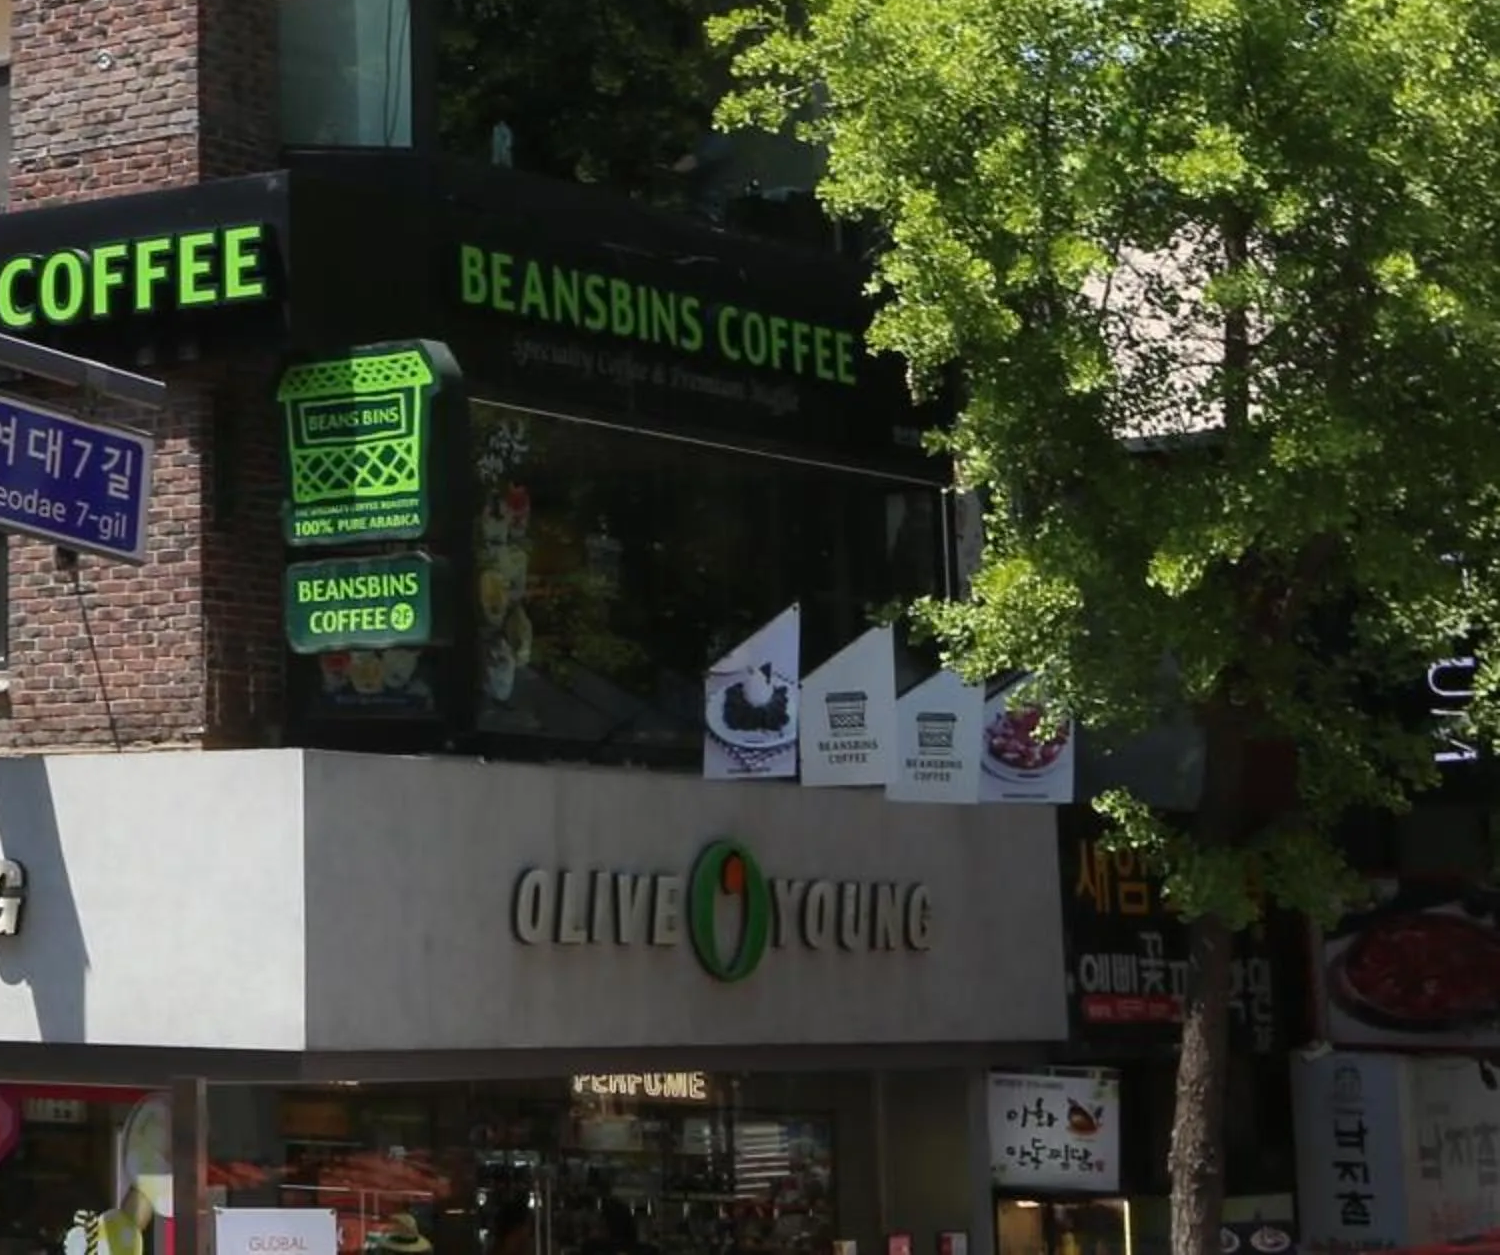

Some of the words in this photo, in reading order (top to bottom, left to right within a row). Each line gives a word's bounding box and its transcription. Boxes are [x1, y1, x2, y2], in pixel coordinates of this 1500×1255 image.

[458, 242, 704, 353] BEANSBINS
[715, 303, 858, 387] COFFEE
[307, 410, 360, 432] BEANS
[361, 405, 400, 427] BINS
[75, 500, 129, 542] 7-gil
[294, 518, 336, 537] 100%
[337, 514, 367, 532] PURE
[368, 511, 421, 529] ARABICA
[296, 571, 420, 603] BEANSBINS
[308, 606, 389, 635] COFFEE
[827, 753, 869, 766] COFFEE
[512, 867, 682, 946] OLIVE
[770, 877, 934, 951] YOUNG
[248, 1234, 309, 1253] GLOBAL
